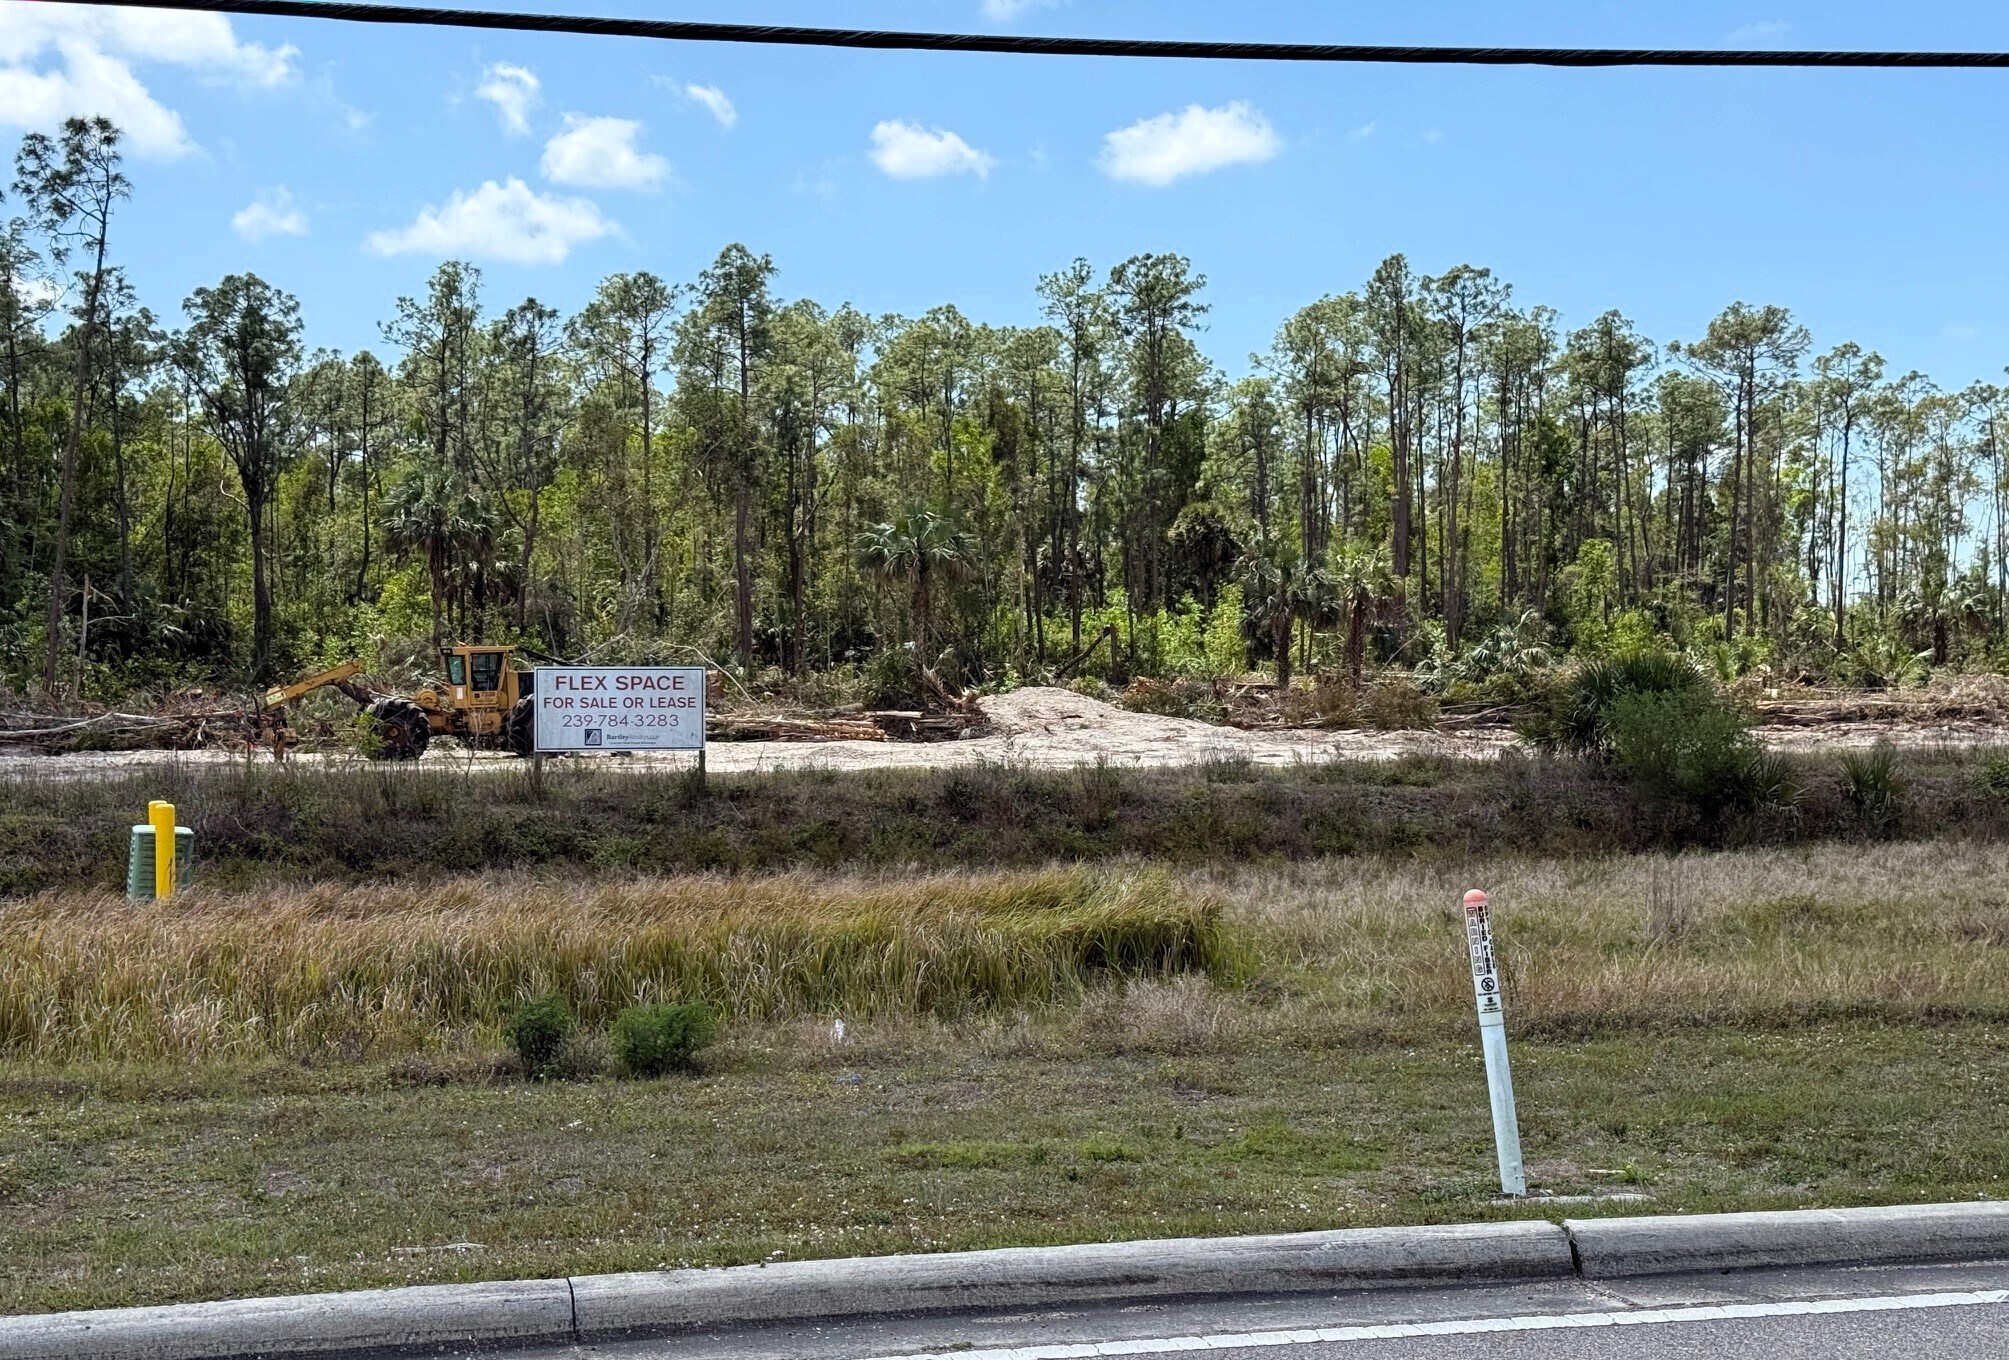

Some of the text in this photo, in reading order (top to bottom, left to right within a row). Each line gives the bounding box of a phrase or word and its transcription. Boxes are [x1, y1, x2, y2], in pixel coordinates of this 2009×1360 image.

[555, 675, 685, 691] FLEX SPACE
[543, 697, 696, 709] FOR SALE OR LEASE
[562, 714, 679, 728] 239-784-3283
[1467, 909, 1483, 973] WARNING
[1478, 906, 1492, 975] BURIED FIBER
